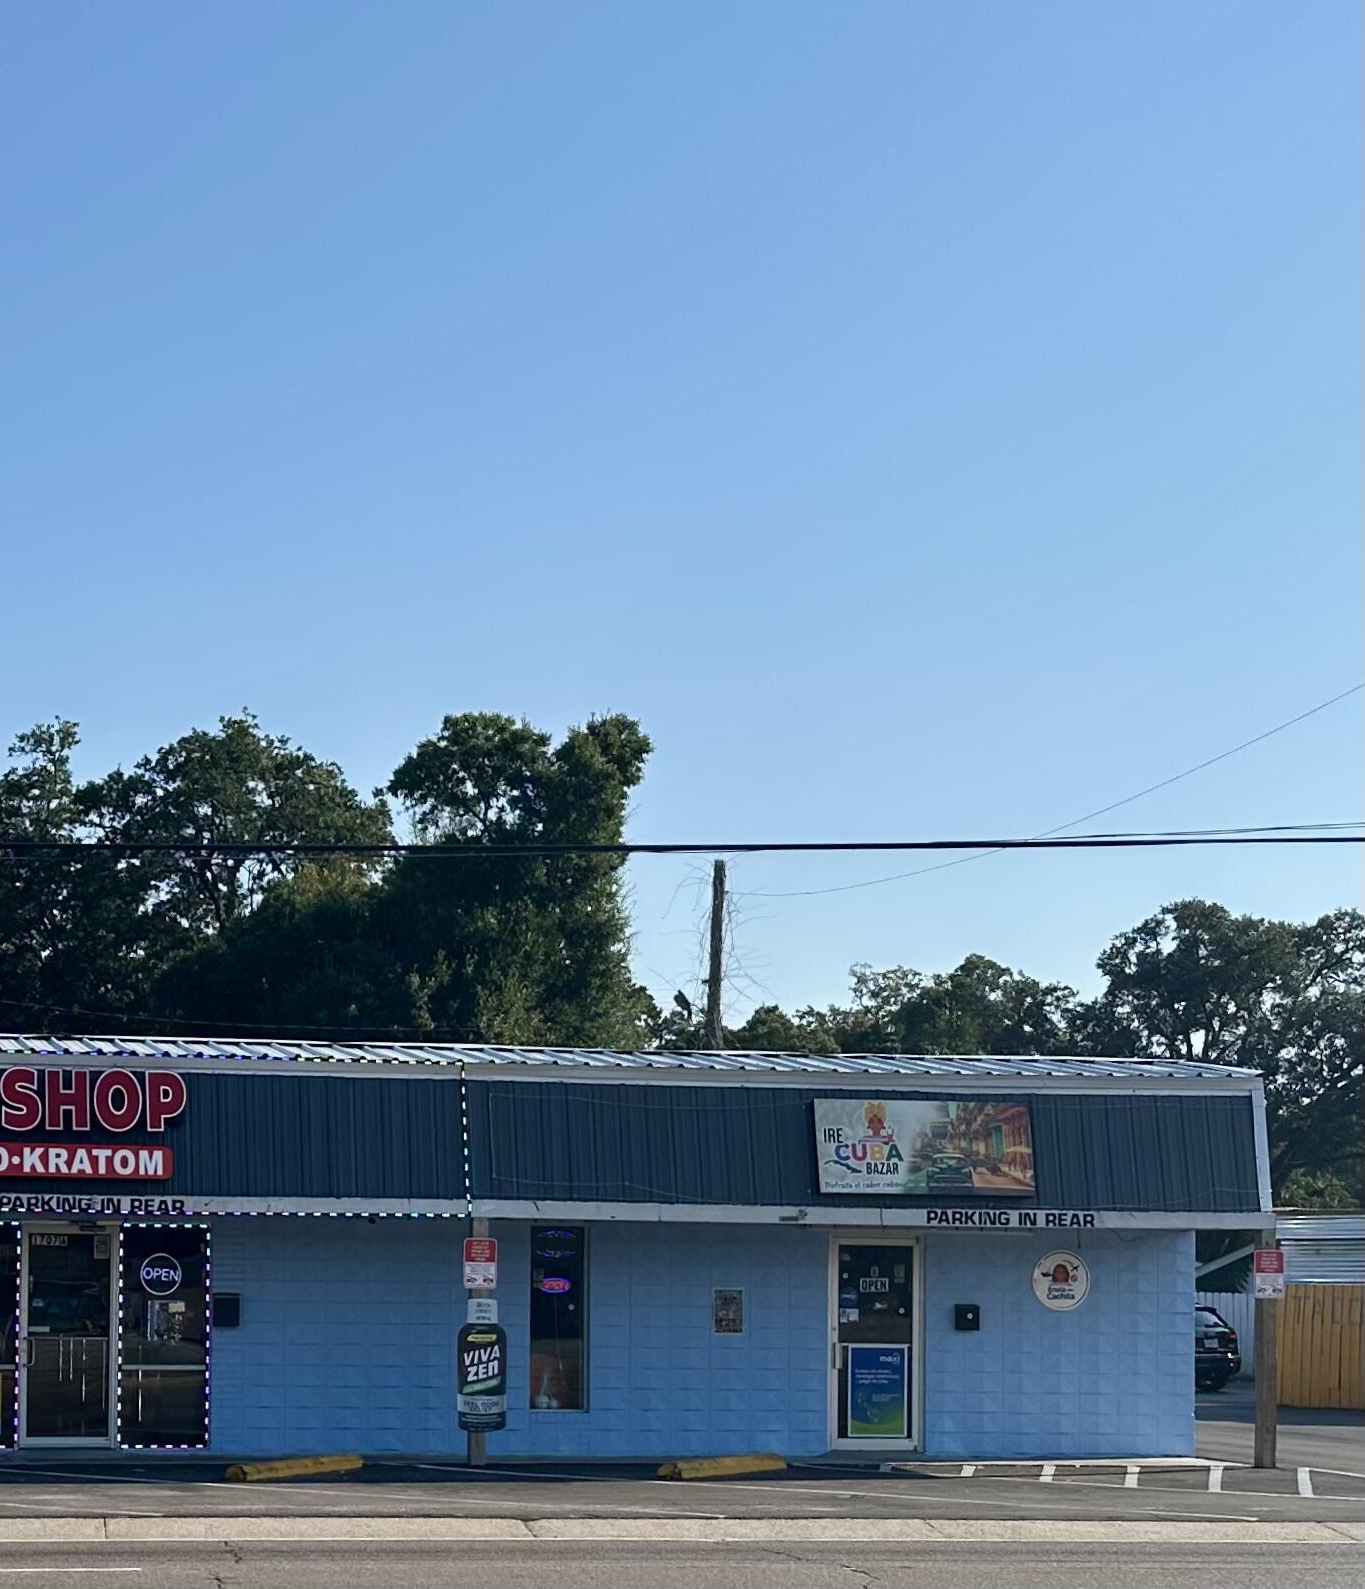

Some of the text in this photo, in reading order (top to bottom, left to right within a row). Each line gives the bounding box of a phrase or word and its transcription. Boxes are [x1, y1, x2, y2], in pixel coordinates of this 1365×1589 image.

[0, 1066, 186, 1132] SHOP
[824, 1127, 843, 1144] IRE
[835, 1143, 904, 1161] CUBA
[866, 1162, 899, 1175] BAZAR
[0, 1195, 185, 1214] PARKING IN REAR
[926, 1209, 1095, 1228] PARKING IN REAR
[143, 1267, 180, 1281] OPEN
[861, 1279, 888, 1291] OPEN
[463, 1344, 501, 1366] VIVA
